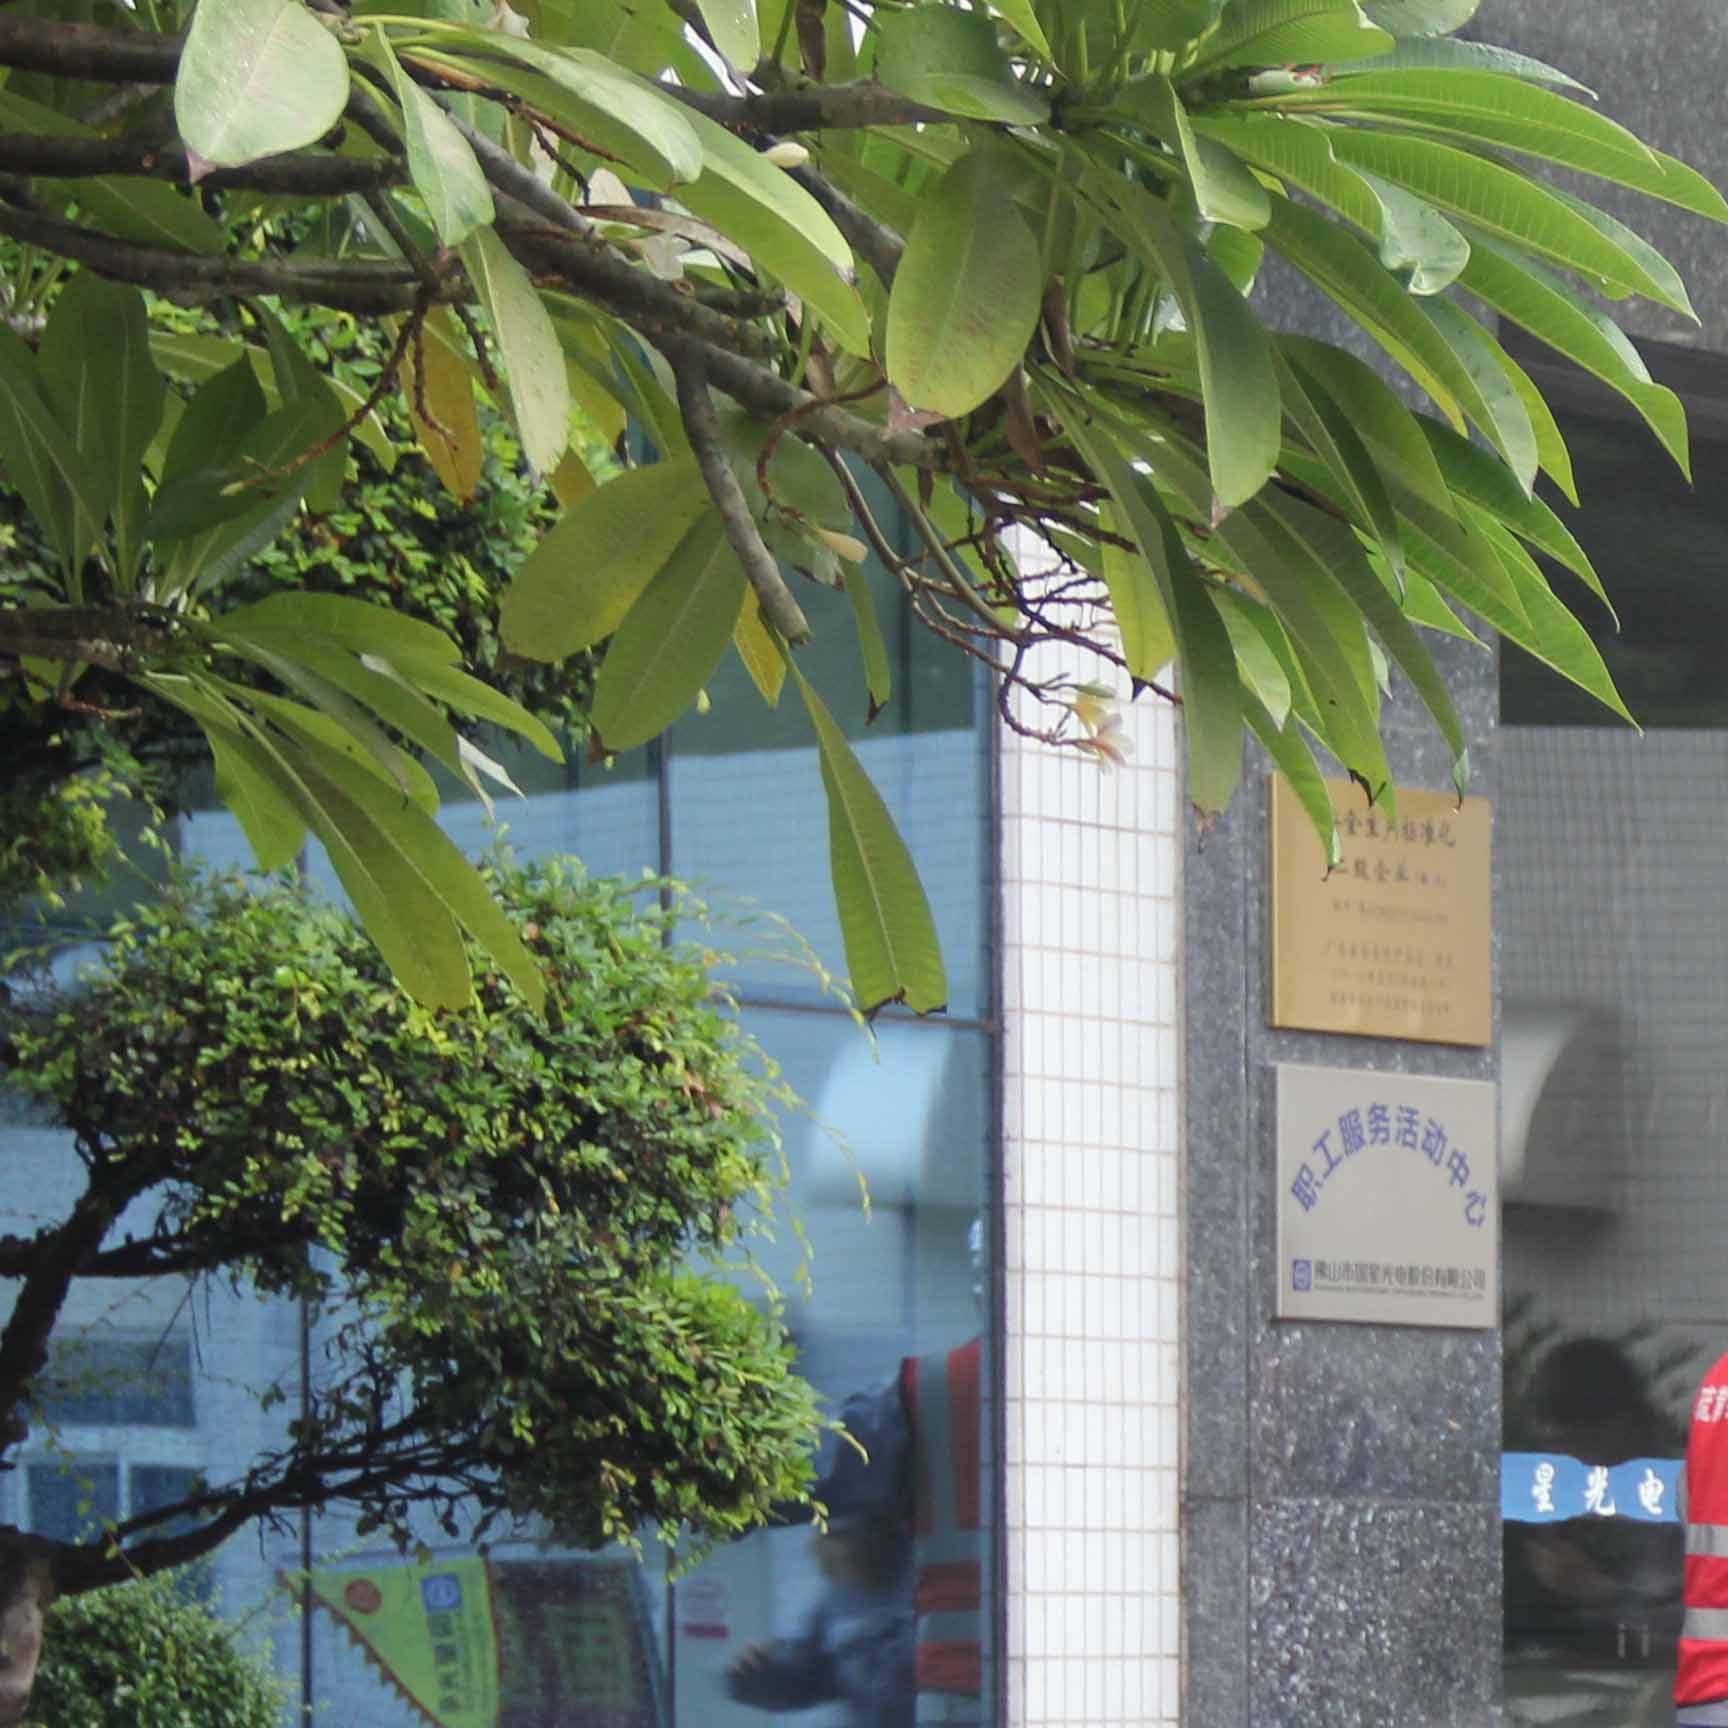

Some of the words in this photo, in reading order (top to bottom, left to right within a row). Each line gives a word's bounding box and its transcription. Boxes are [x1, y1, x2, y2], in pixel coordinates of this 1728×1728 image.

[1332, 808, 1457, 848] 全生产标准化
[1291, 1102, 1487, 1227] 职工服务活动中心
